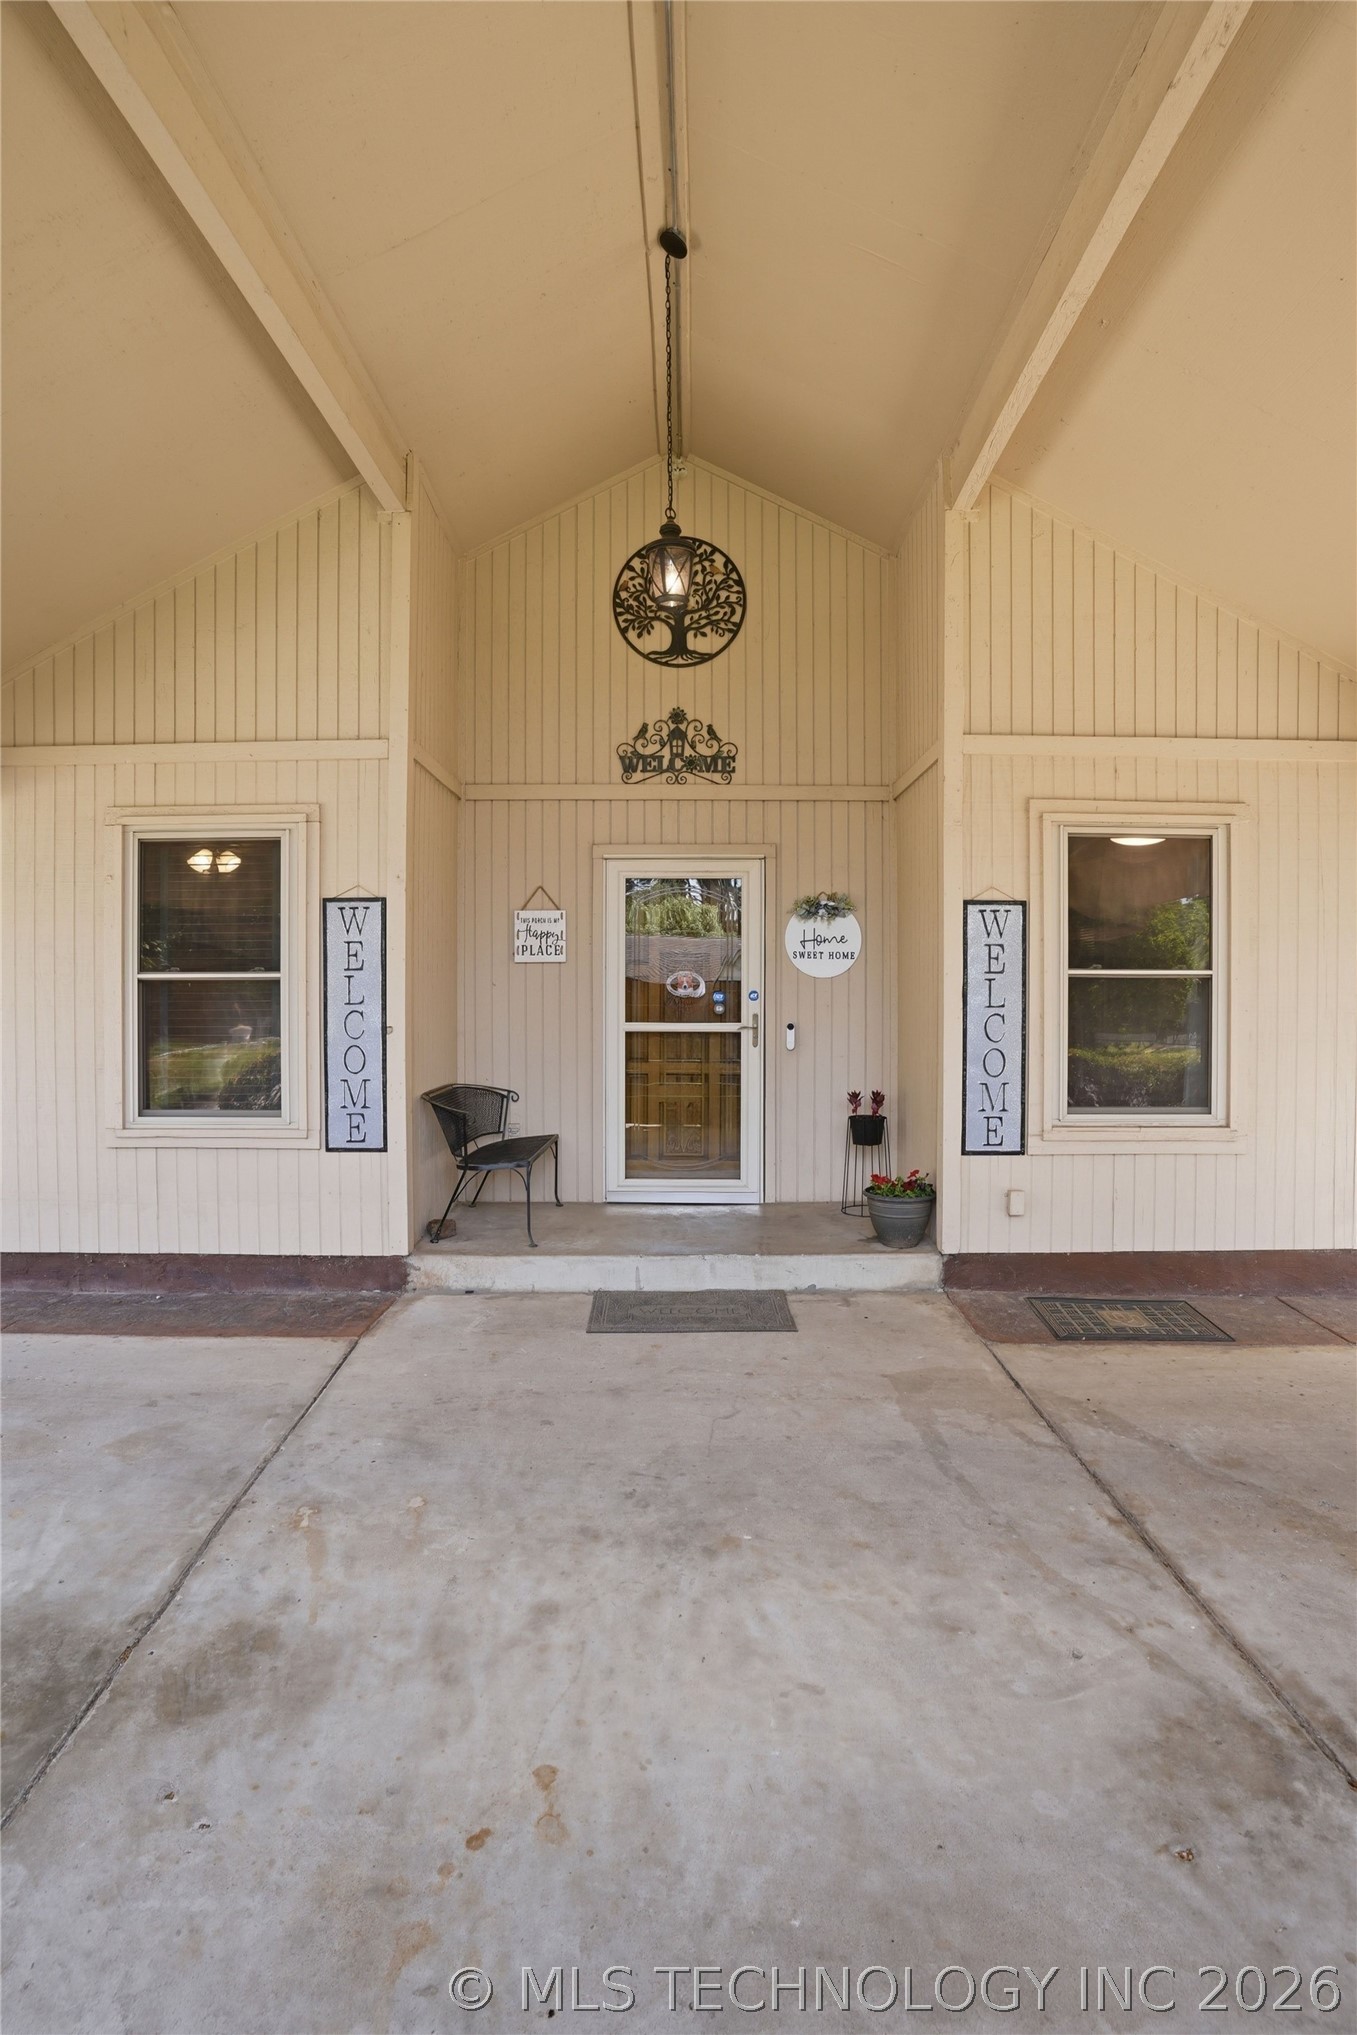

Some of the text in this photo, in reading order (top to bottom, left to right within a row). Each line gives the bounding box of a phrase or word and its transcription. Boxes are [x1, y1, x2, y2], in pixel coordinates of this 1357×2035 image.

[619, 755, 736, 773] WELCME
[518, 923, 561, 945] Happy
[800, 927, 849, 950] Home
[521, 944, 561, 956] PLACE
[792, 951, 856, 960] SWEET HOME
[337, 906, 372, 1143] WELCOME
[978, 909, 1012, 1147] WELCOME
[639, 1306, 743, 1315] WELCOME
